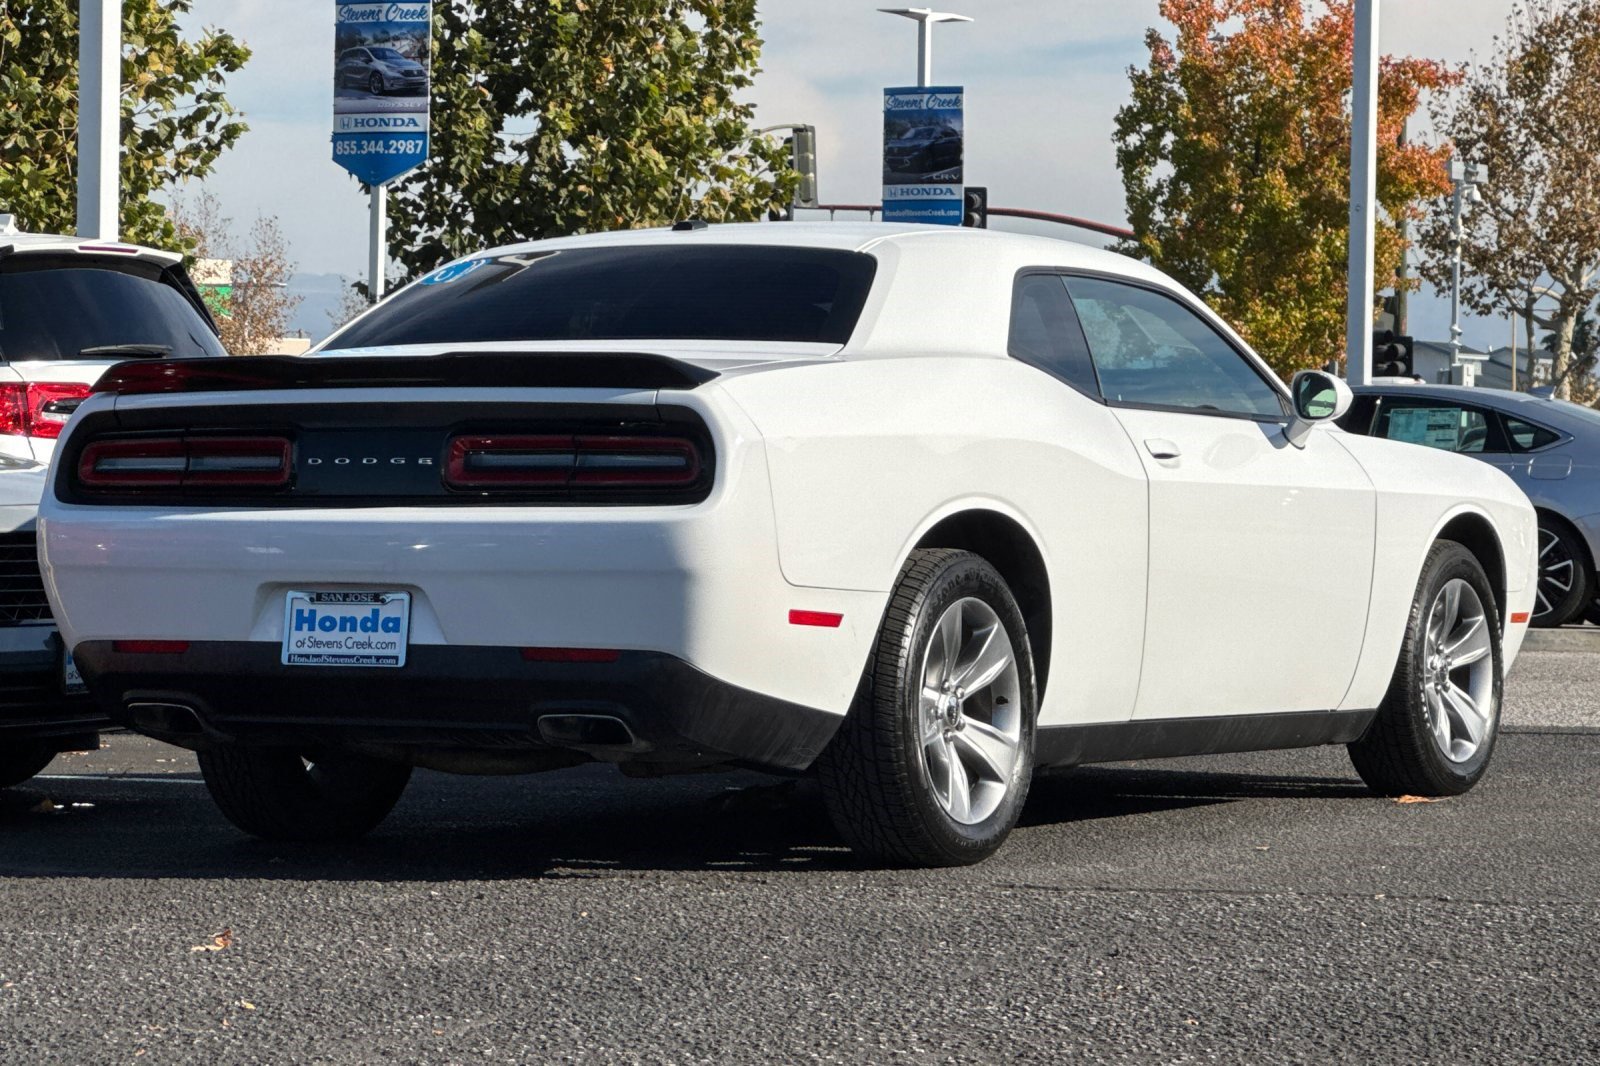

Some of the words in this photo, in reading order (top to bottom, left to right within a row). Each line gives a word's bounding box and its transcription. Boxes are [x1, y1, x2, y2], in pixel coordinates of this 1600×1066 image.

[338, 4, 382, 23] Stevens
[385, 3, 428, 22] Creek
[886, 95, 923, 111] Stevens
[925, 94, 961, 109] Creek
[353, 117, 420, 128] HONDA
[336, 139, 424, 154] 855.344.2987
[900, 187, 956, 197] HONDA
[307, 457, 433, 465] DODGE
[320, 592, 343, 602] SAN
[346, 593, 375, 602] JOSE
[295, 608, 401, 633] Honda
[295, 637, 307, 649] of
